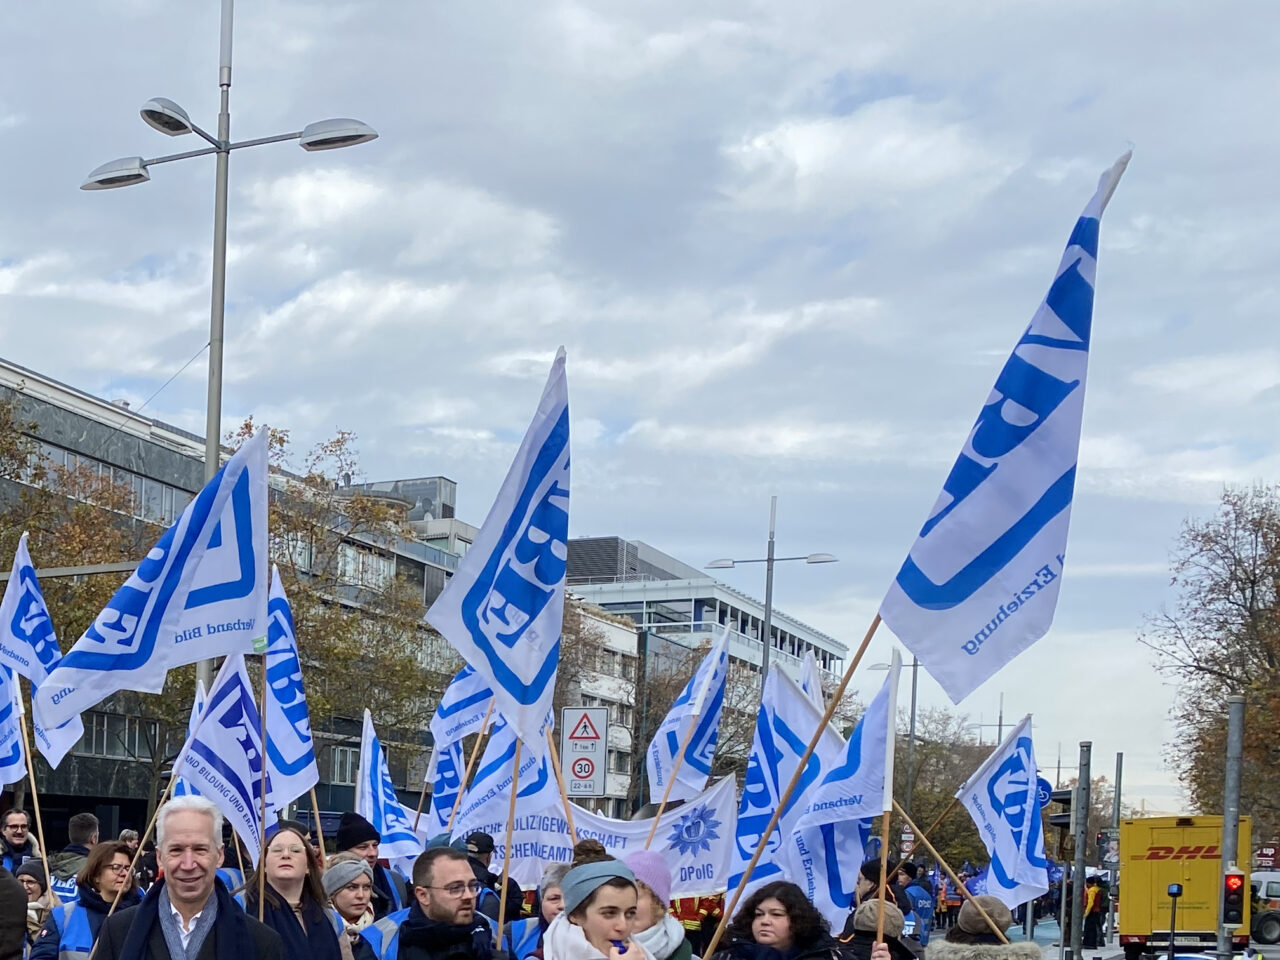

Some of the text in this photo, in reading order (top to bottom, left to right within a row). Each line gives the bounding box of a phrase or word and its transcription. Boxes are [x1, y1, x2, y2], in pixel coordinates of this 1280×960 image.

[577, 763, 591, 774] 30
[199, 765, 230, 798] BILDUNG
[229, 794, 245, 813] UND
[796, 837, 809, 856] und
[1145, 845, 1222, 860] DHL
[680, 863, 714, 882] DPolG
